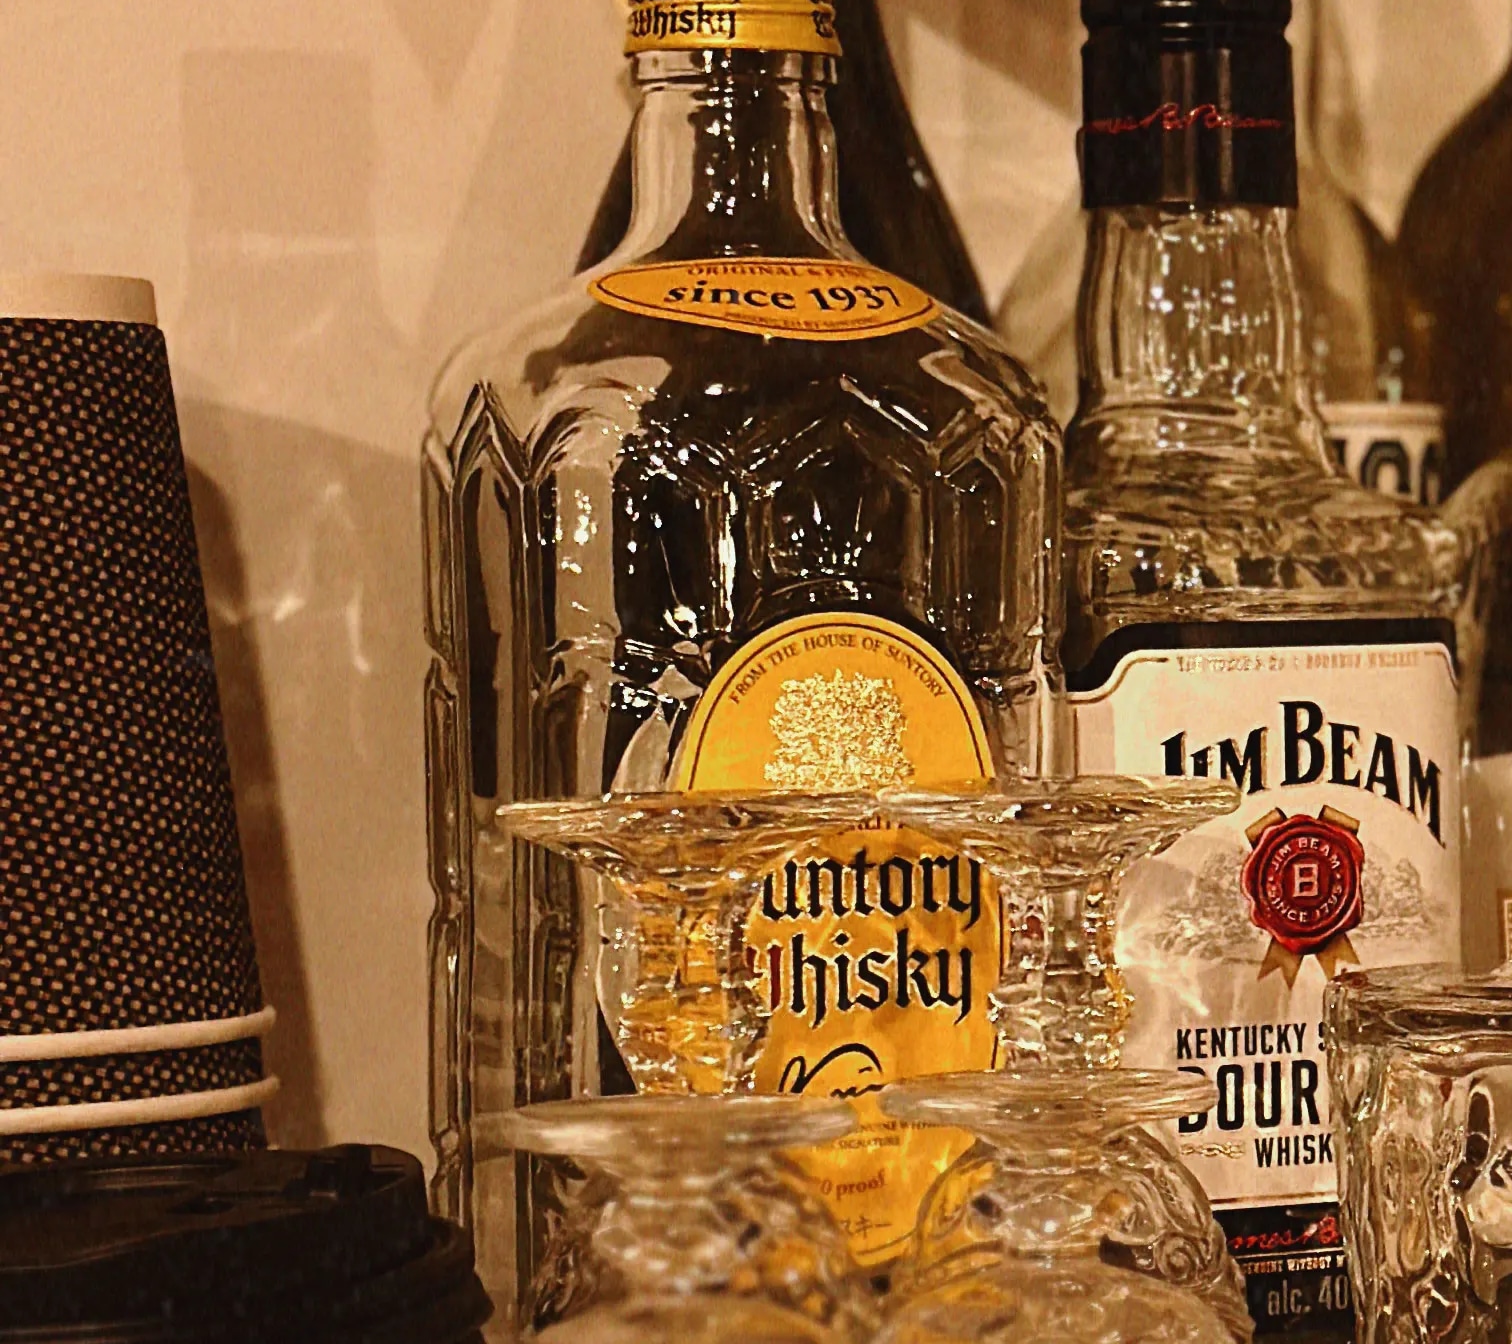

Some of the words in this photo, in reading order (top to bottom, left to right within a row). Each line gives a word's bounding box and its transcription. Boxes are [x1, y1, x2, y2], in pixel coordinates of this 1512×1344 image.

[630, 1, 737, 39] Whisky
[664, 270, 796, 311] since
[809, 285, 901, 311] 1937
[729, 663, 768, 706] FROM
[768, 641, 798, 667] THE
[803, 634, 857, 652] HOUSE
[861, 635, 884, 653] OF
[884, 645, 949, 699] SUNTORY
[1279, 700, 1446, 849] BEAM
[1271, 843, 1292, 872] JIM
[1297, 836, 1341, 870] BEAM
[762, 847, 981, 931] untory
[1176, 1022, 1307, 1060] KENTUCKY
[836, 1170, 885, 1199] proof
[1267, 1279, 1311, 1317] alc.
